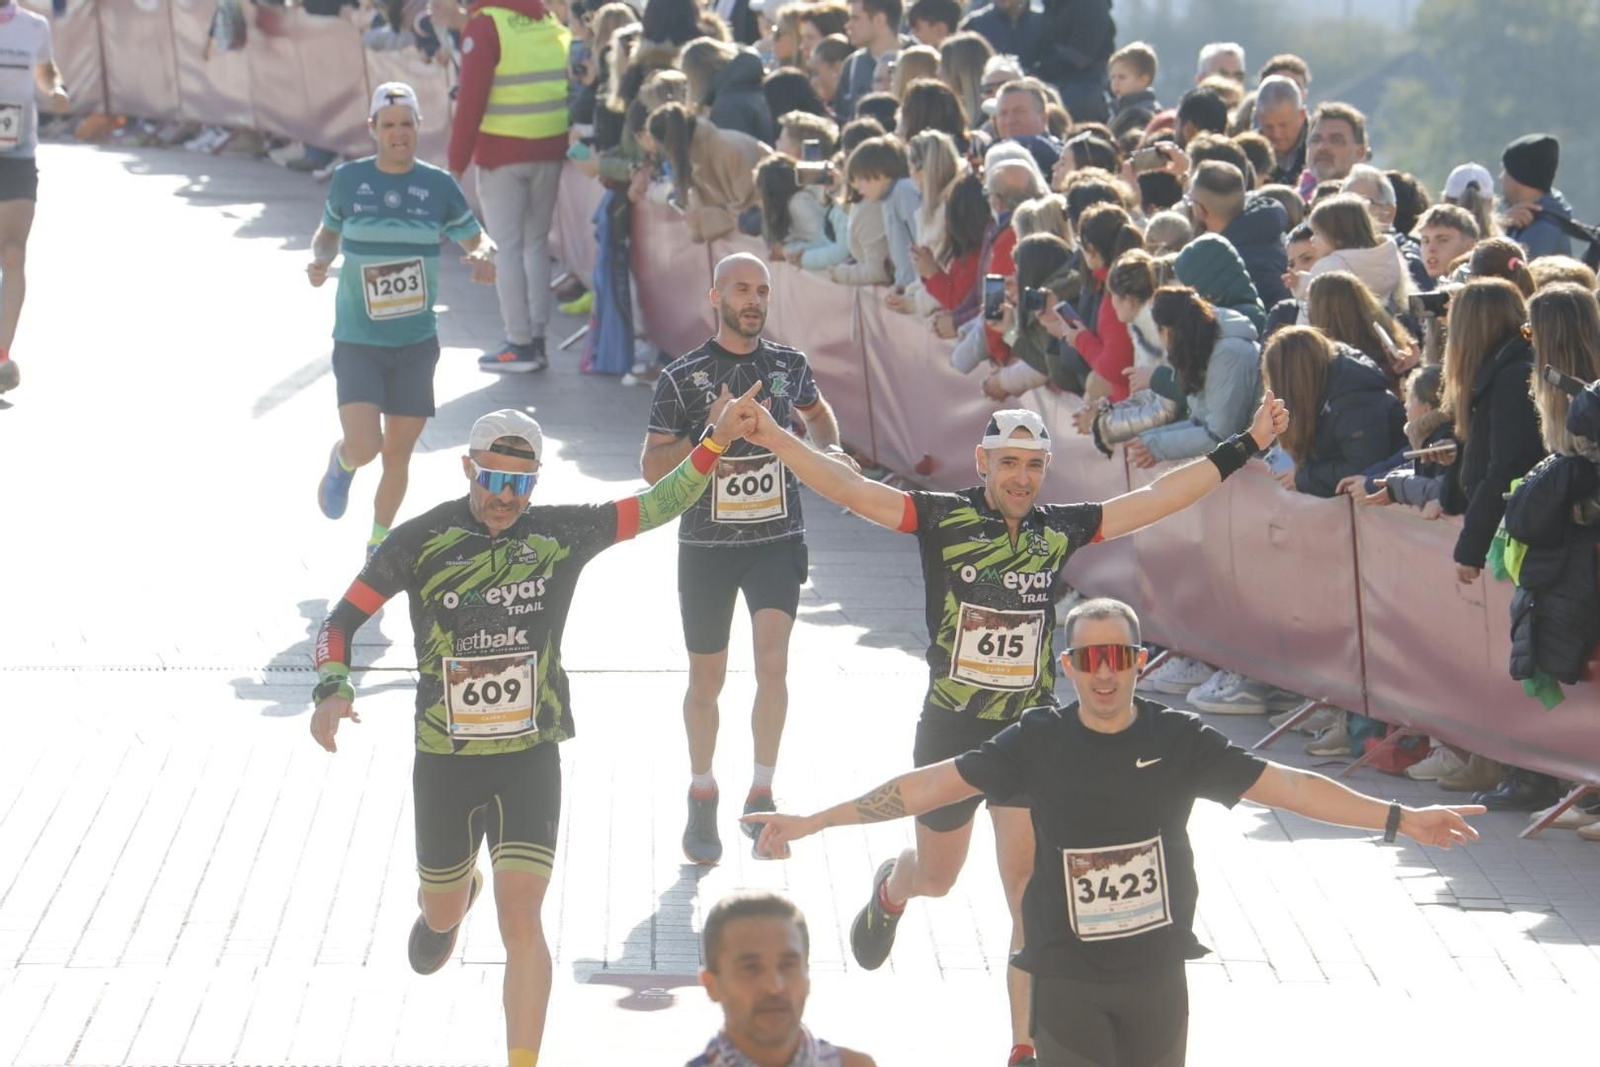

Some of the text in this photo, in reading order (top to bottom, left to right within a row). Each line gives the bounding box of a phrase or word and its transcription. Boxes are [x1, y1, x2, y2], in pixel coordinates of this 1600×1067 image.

[373, 275, 419, 296] 1203
[726, 474, 774, 496] 600
[506, 602, 544, 616] TRAIL
[977, 633, 1024, 658] 615
[462, 678, 521, 706] 609
[1077, 868, 1158, 904] 3423
